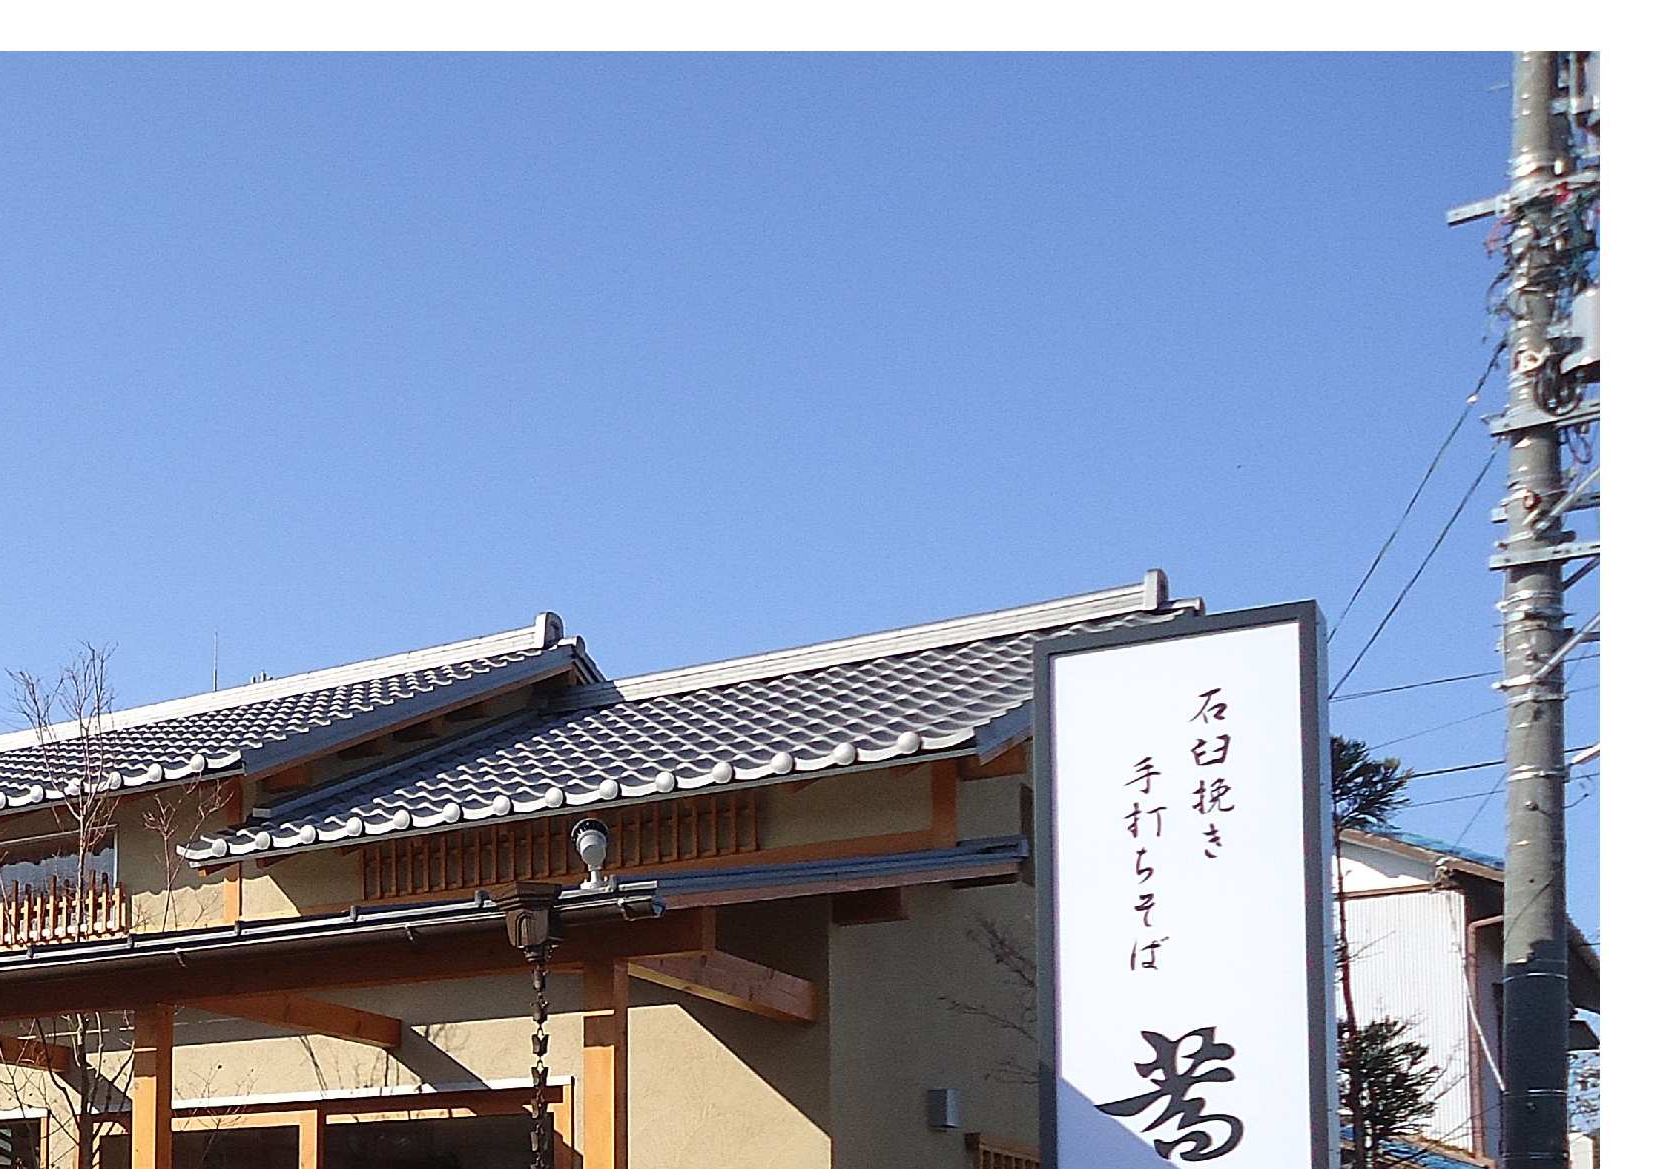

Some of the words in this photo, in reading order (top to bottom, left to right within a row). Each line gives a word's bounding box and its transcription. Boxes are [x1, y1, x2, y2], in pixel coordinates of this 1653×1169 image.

[1123, 756, 1170, 971] 手打ちそば
[1189, 687, 1235, 859] 石臼挽き
